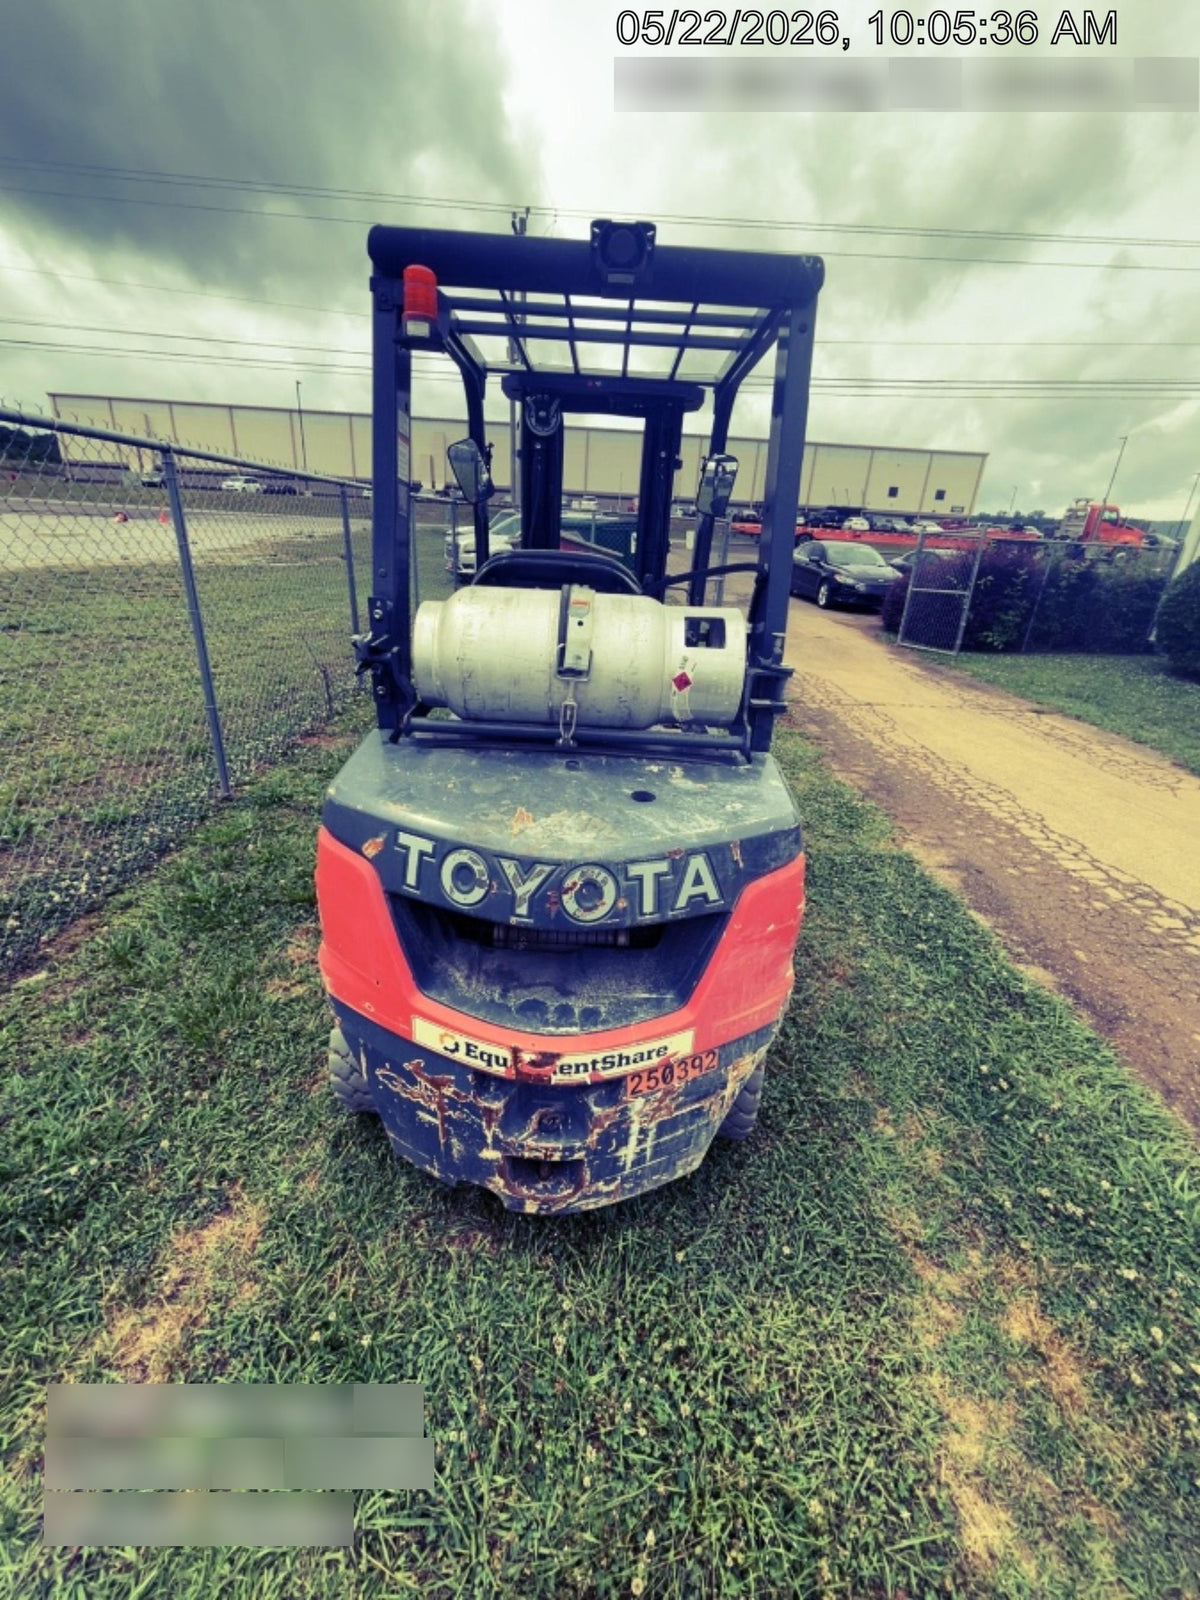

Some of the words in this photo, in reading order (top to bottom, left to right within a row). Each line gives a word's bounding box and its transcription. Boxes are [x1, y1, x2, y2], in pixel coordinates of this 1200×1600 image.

[395, 831, 725, 925] TOYOTA
[464, 1041, 669, 1076] EquentShare
[630, 1050, 717, 1096] 250392
